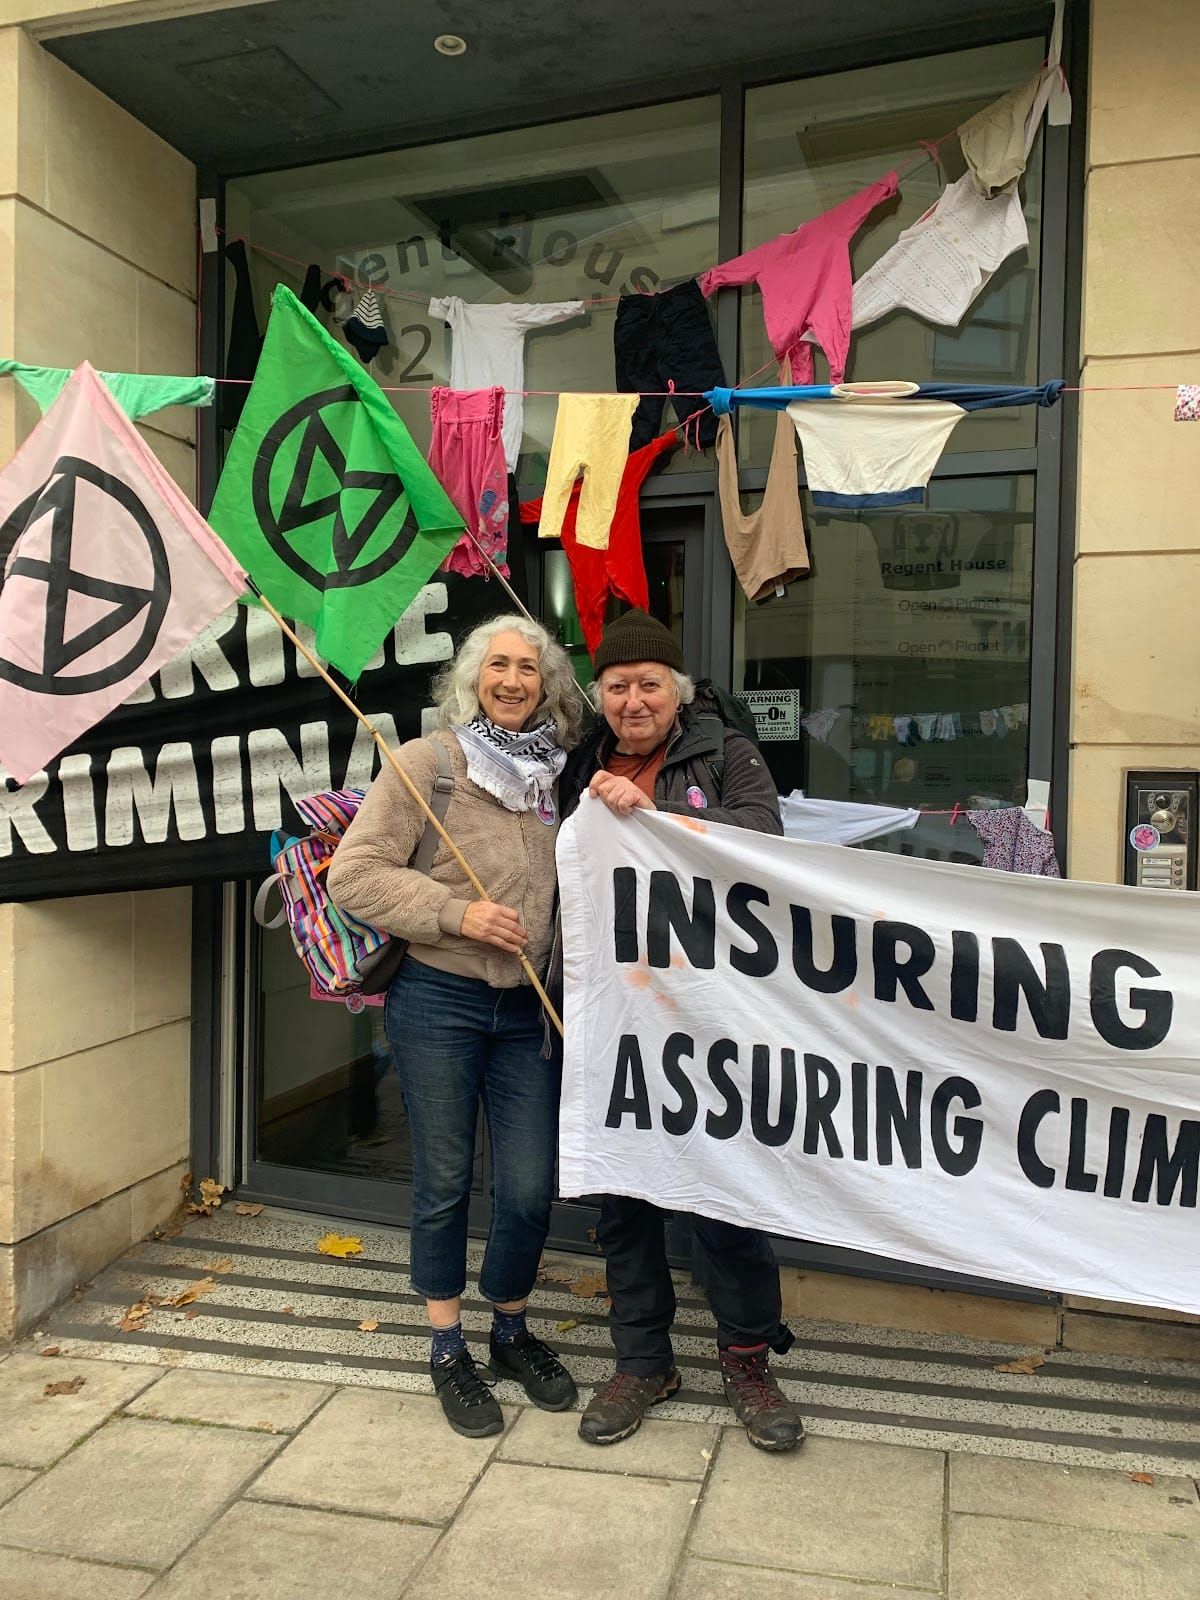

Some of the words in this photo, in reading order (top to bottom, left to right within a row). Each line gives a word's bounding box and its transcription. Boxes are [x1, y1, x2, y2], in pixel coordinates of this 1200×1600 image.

[493, 211, 661, 296] Hous
[881, 560, 944, 576] Regent
[951, 559, 1007, 571] House
[898, 599, 937, 615] Open
[898, 641, 937, 656] Open
[955, 640, 1001, 652] Planet
[0, 706, 450, 857] RIMINA
[613, 866, 1174, 1051] INSURING
[604, 1031, 985, 1177] ASSURING
[1016, 1088, 1200, 1208] CLIM
